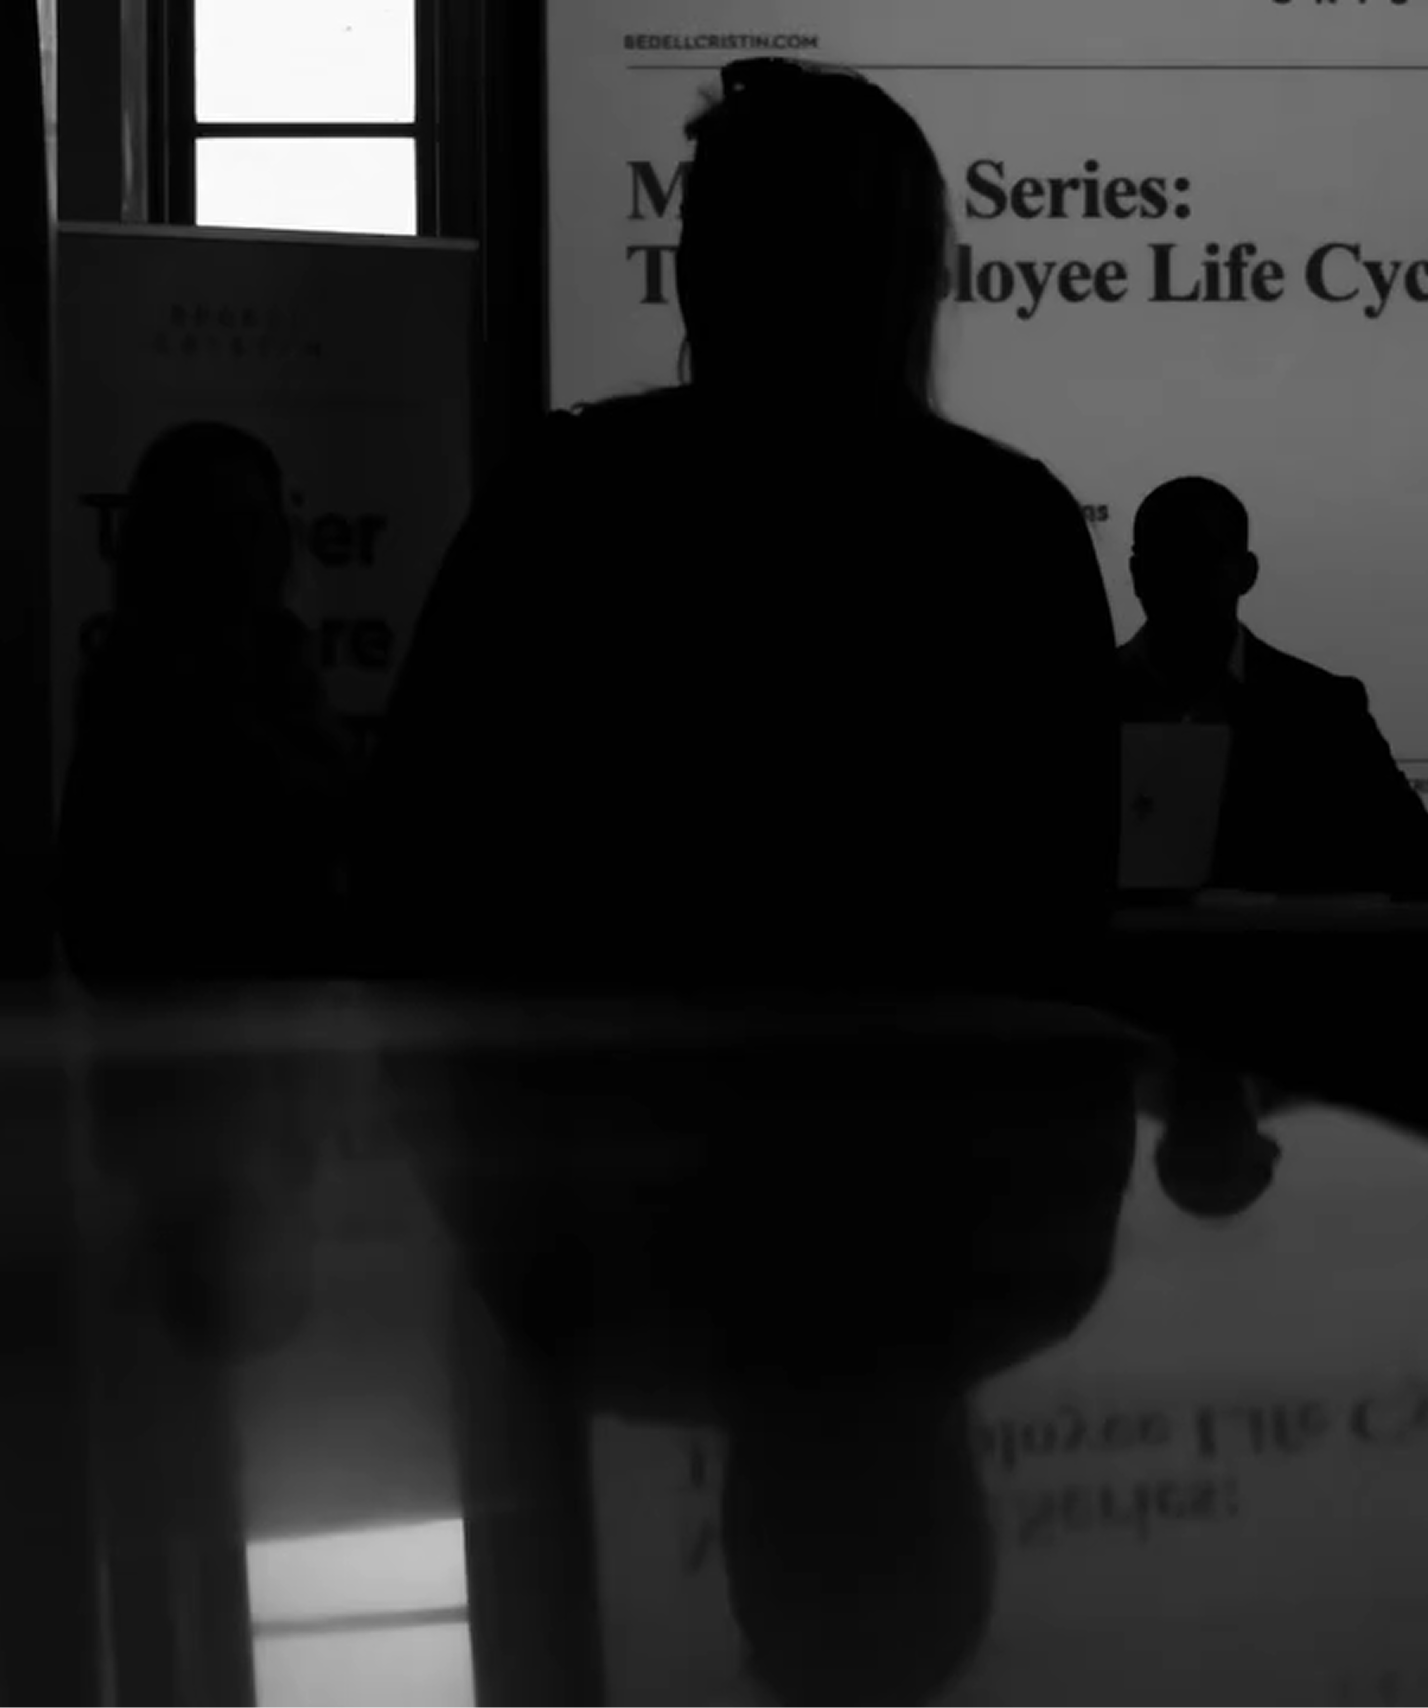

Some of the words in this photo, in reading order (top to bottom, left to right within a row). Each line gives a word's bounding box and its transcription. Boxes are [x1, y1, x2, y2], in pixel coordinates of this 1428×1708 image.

[624, 34, 819, 50] BEDELLCRISTIN.COM
[965, 159, 1191, 219] Series:
[938, 243, 1127, 319] loyee
[1148, 242, 1284, 302] Life
